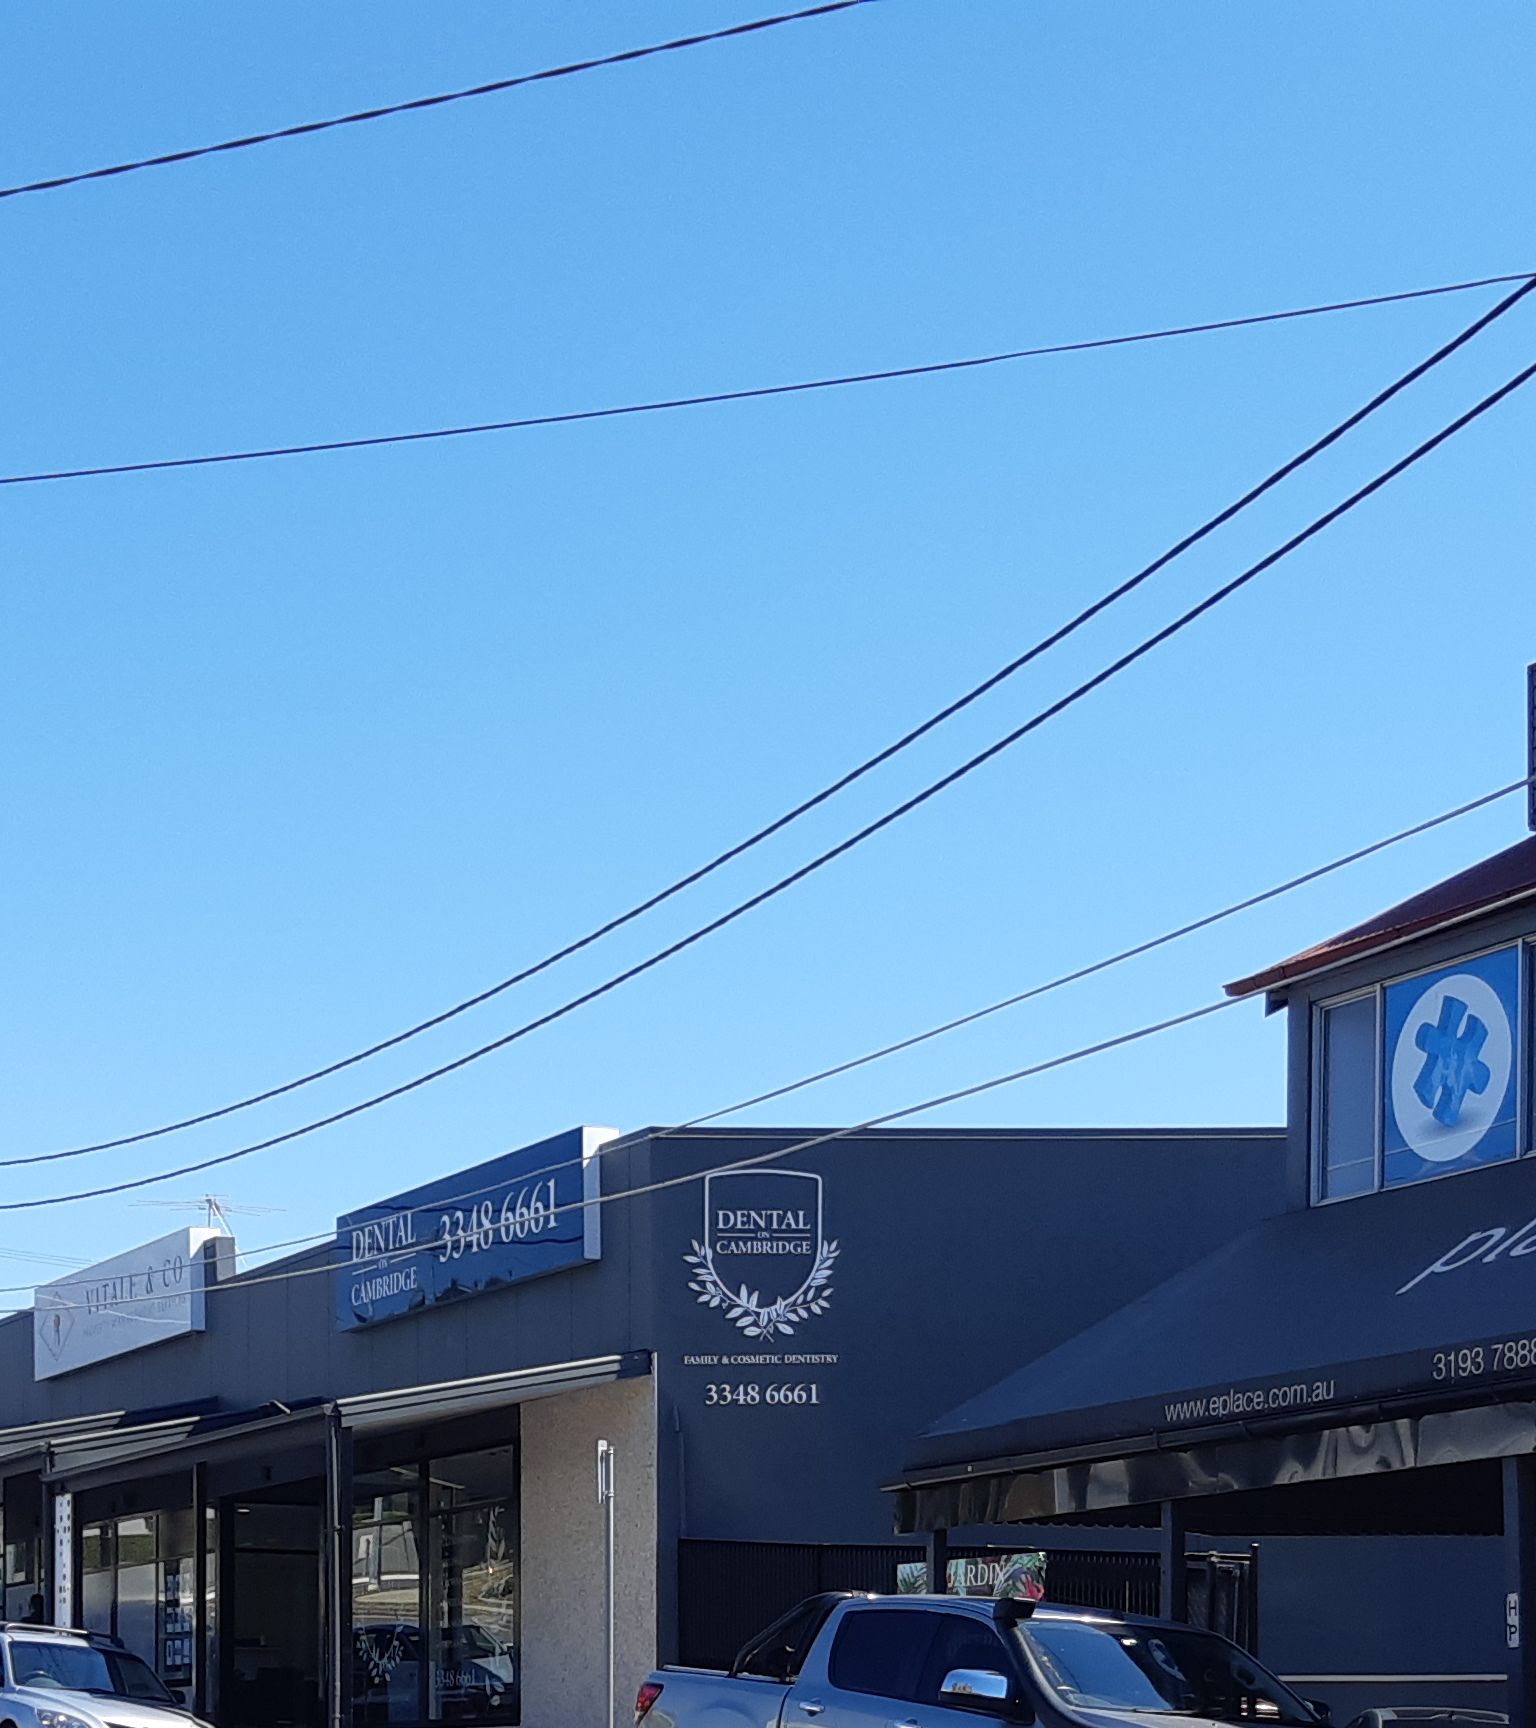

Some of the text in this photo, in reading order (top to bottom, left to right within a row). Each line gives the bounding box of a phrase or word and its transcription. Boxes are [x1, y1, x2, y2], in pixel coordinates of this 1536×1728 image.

[351, 1178, 560, 1263] DENTAL 3348 6661
[716, 1210, 811, 1230] DENTAL
[716, 1240, 812, 1255] CAMBRIDGE
[351, 1266, 418, 1307] CAMBRIDGE
[684, 1354, 719, 1365] FAMILY
[730, 1354, 782, 1364] COSMETIC
[784, 1353, 839, 1364] DENTISTRY
[705, 1383, 820, 1405] 3348 6661
[1165, 1378, 1335, 1422] www.eplace.com.au
[1432, 1346, 1484, 1381] 3193
